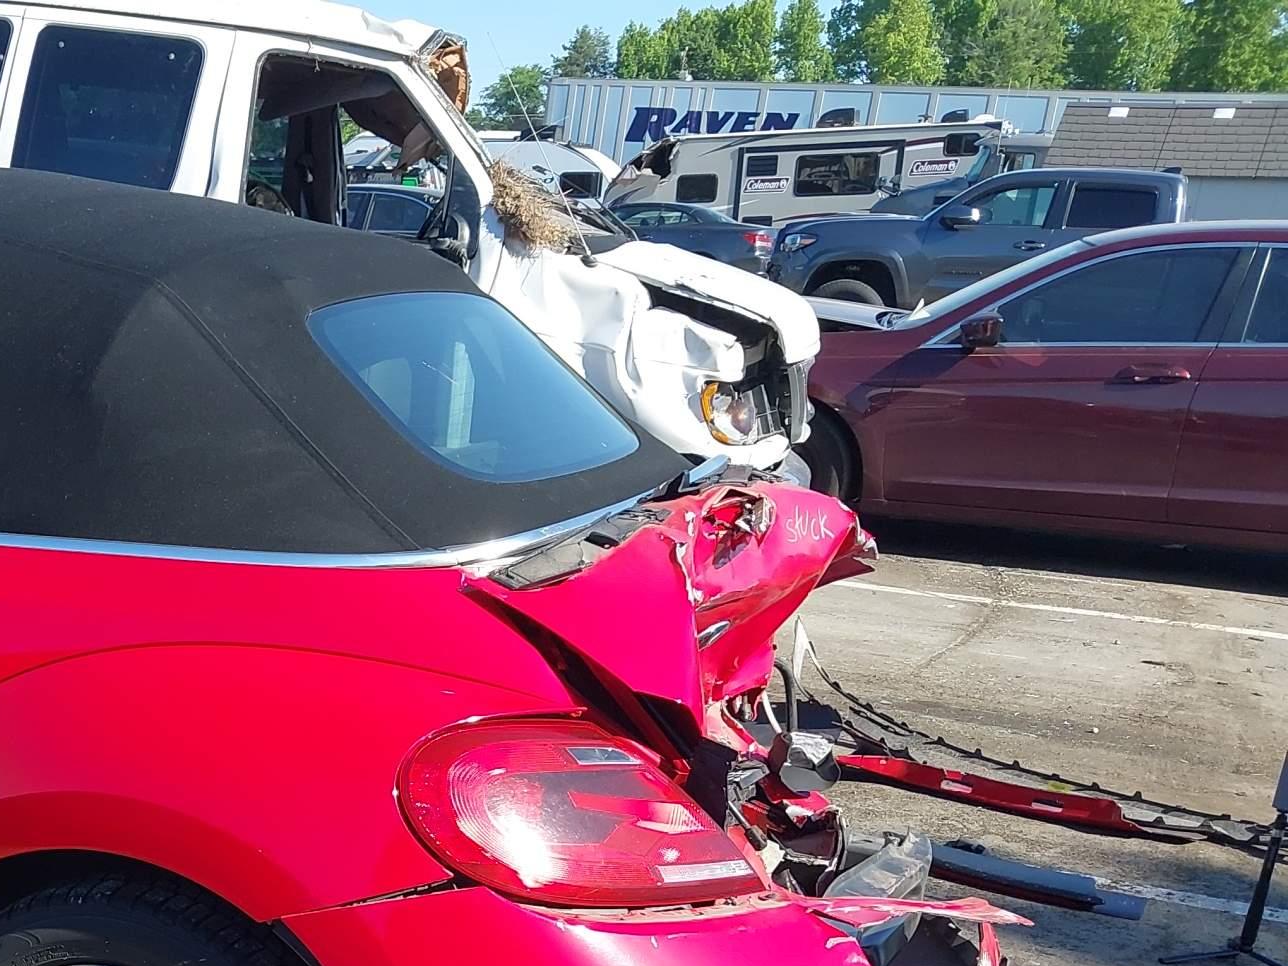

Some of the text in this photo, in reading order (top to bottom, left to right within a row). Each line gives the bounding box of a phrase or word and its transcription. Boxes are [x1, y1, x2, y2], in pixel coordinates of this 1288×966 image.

[625, 107, 800, 142] RAVEN
[912, 161, 947, 173] Coleman
[747, 179, 780, 190] Coleman
